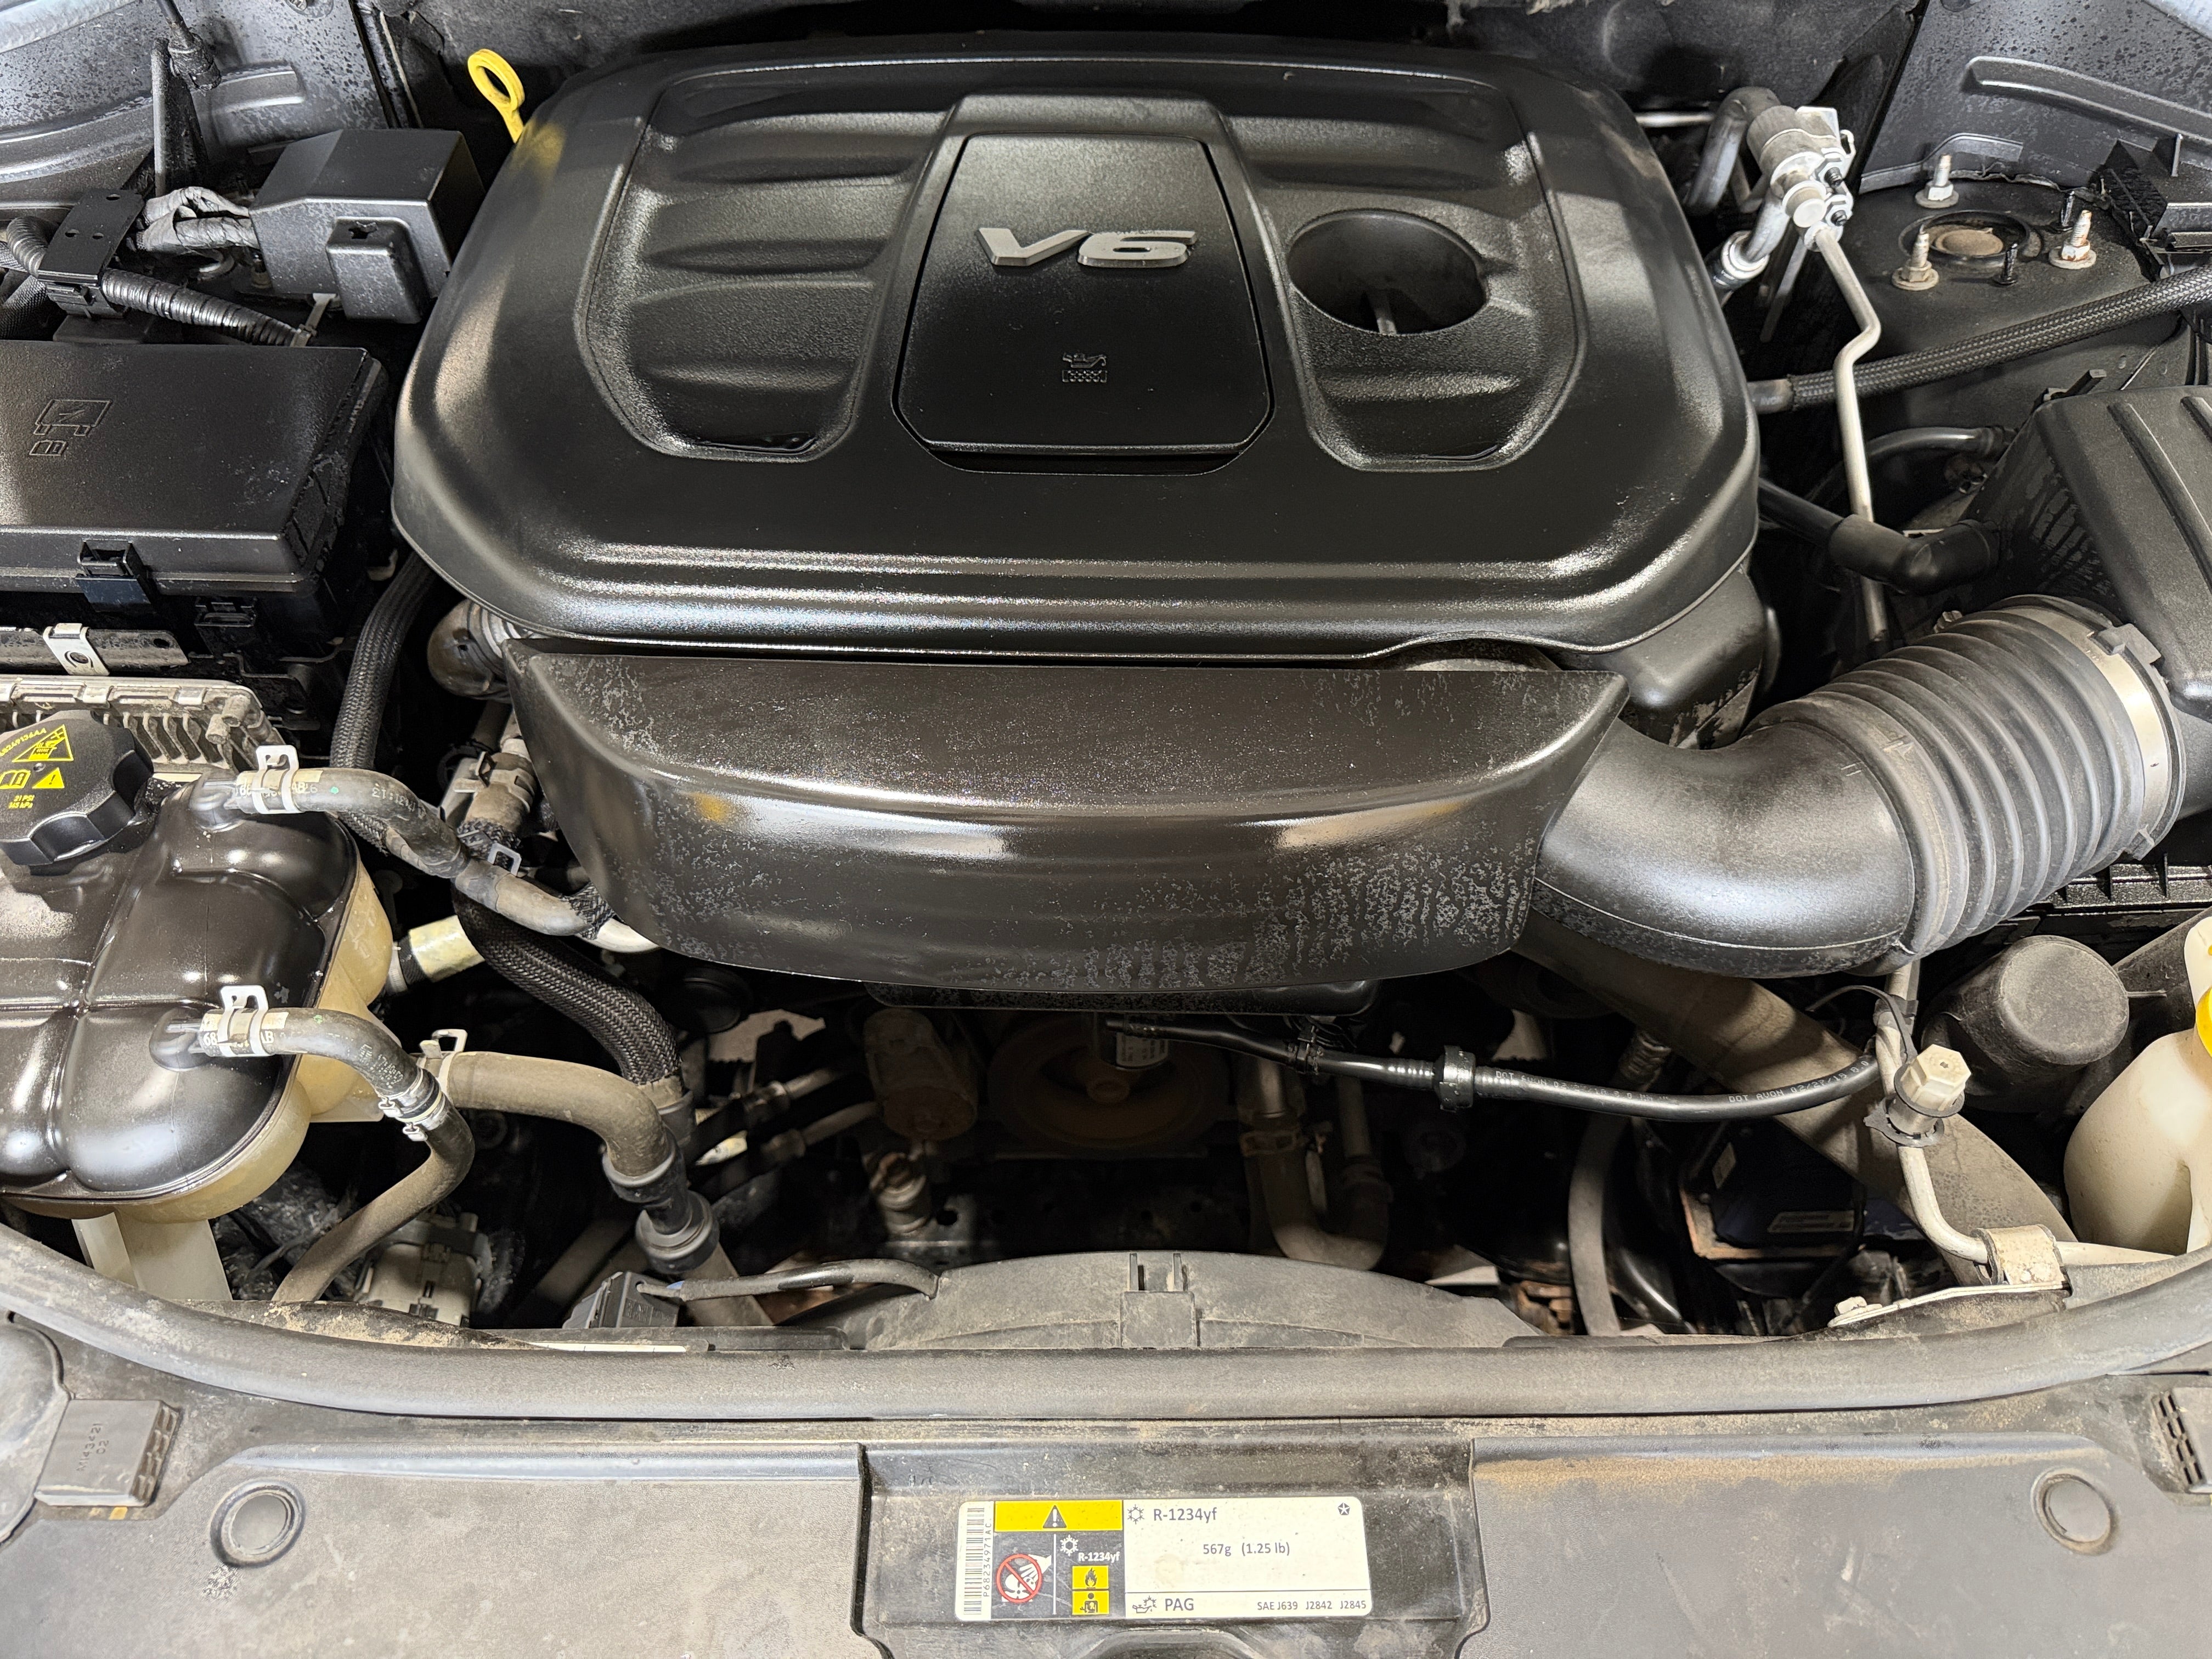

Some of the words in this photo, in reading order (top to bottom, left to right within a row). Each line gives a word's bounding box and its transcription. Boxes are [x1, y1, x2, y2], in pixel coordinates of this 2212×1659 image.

[975, 227, 1198, 268] V6
[1728, 1094, 1749, 1103] DOT
[1153, 1506, 1217, 1523] R-1234yf
[1203, 1543, 1232, 1557] 567g
[1241, 1542, 1272, 1556] (1.25
[1275, 1542, 1290, 1556] lb)
[1077, 1551, 1120, 1564] R-1234yf
[1165, 1598, 1194, 1611] PAG
[1257, 1601, 1275, 1611] SAE
[1277, 1601, 1298, 1610] J639
[1305, 1600, 1333, 1610] J2842
[1340, 1600, 1367, 1610] J2845
